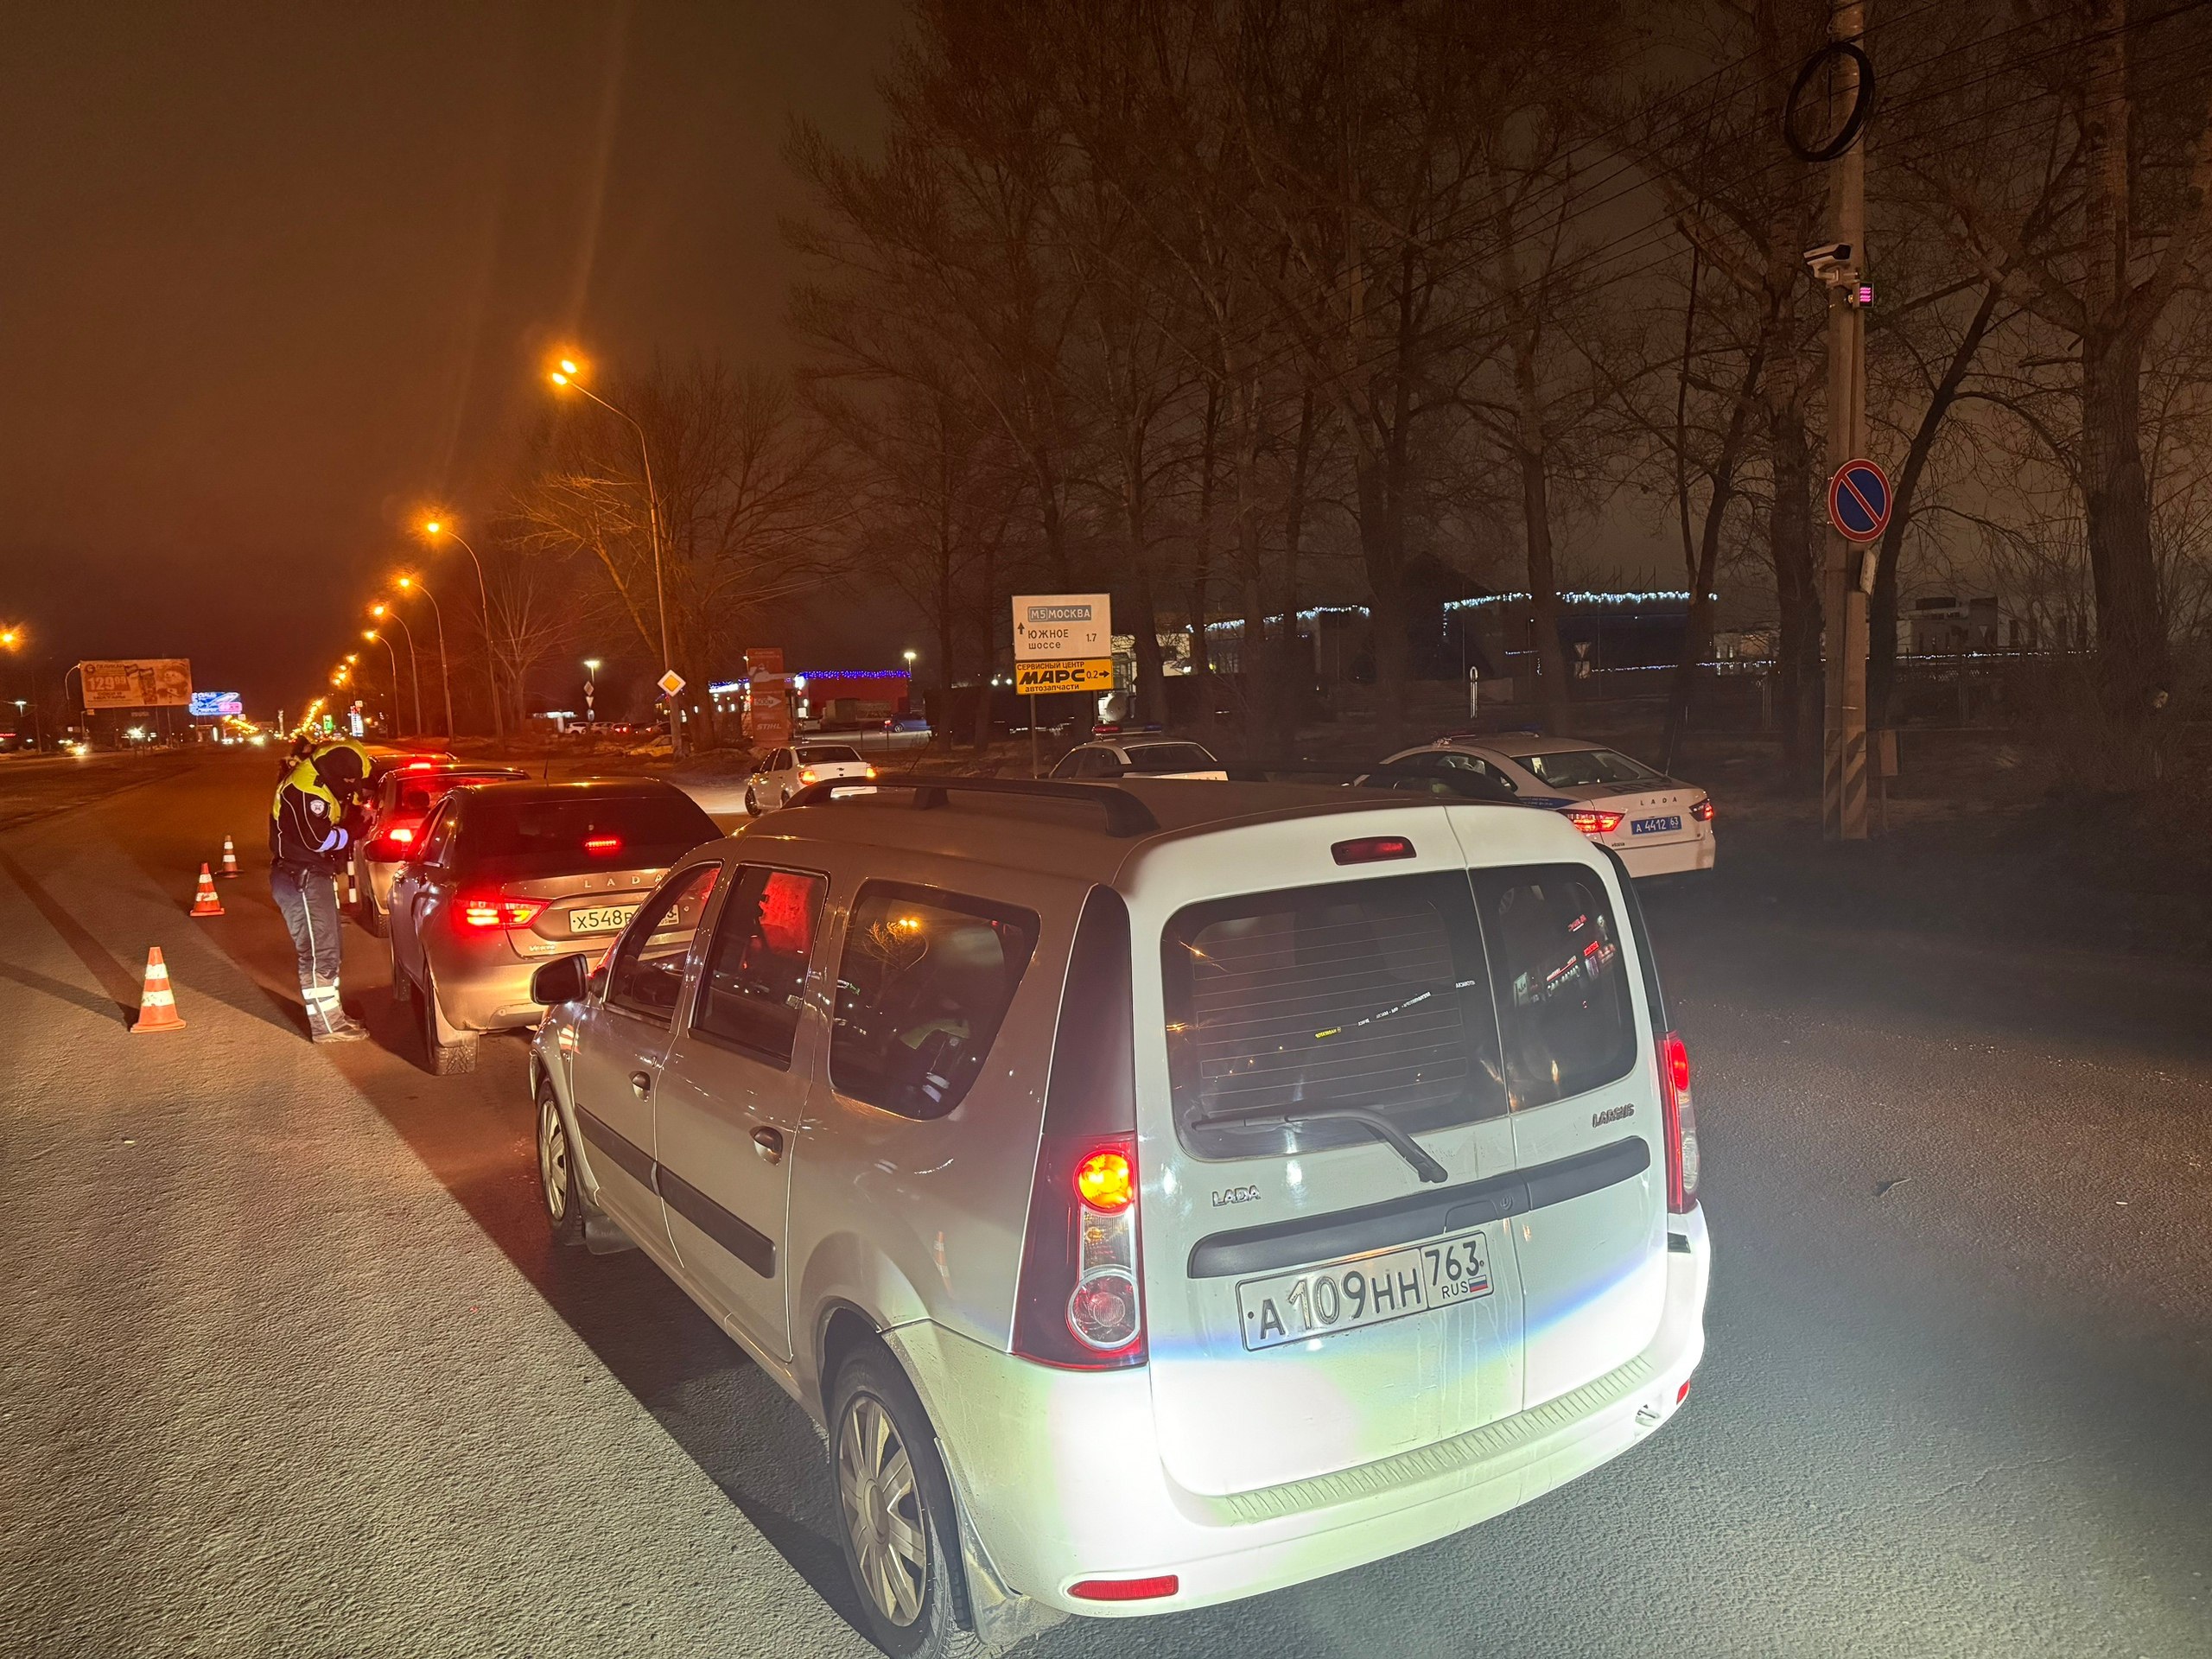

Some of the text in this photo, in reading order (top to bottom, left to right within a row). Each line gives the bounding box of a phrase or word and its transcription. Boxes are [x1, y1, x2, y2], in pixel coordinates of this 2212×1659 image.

[1031, 608, 1090, 620] М5 МОСКВА
[1028, 629, 1069, 639] ЮЖНОЕ
[1086, 633, 1097, 642] 1.7
[1062, 661, 1085, 670] ЦЕНТР
[1019, 669, 1085, 685] МАРС
[1086, 671, 1098, 679] 0.2
[1640, 797, 1678, 806] LADA
[1636, 817, 1679, 833] А 4412 63
[584, 874, 664, 888] LADA
[1592, 1103, 1635, 1128] LARGUS
[1211, 1185, 1262, 1207] LADA
[1260, 1241, 1481, 1341] А109НН 763
[1441, 1281, 1469, 1300] RUS
